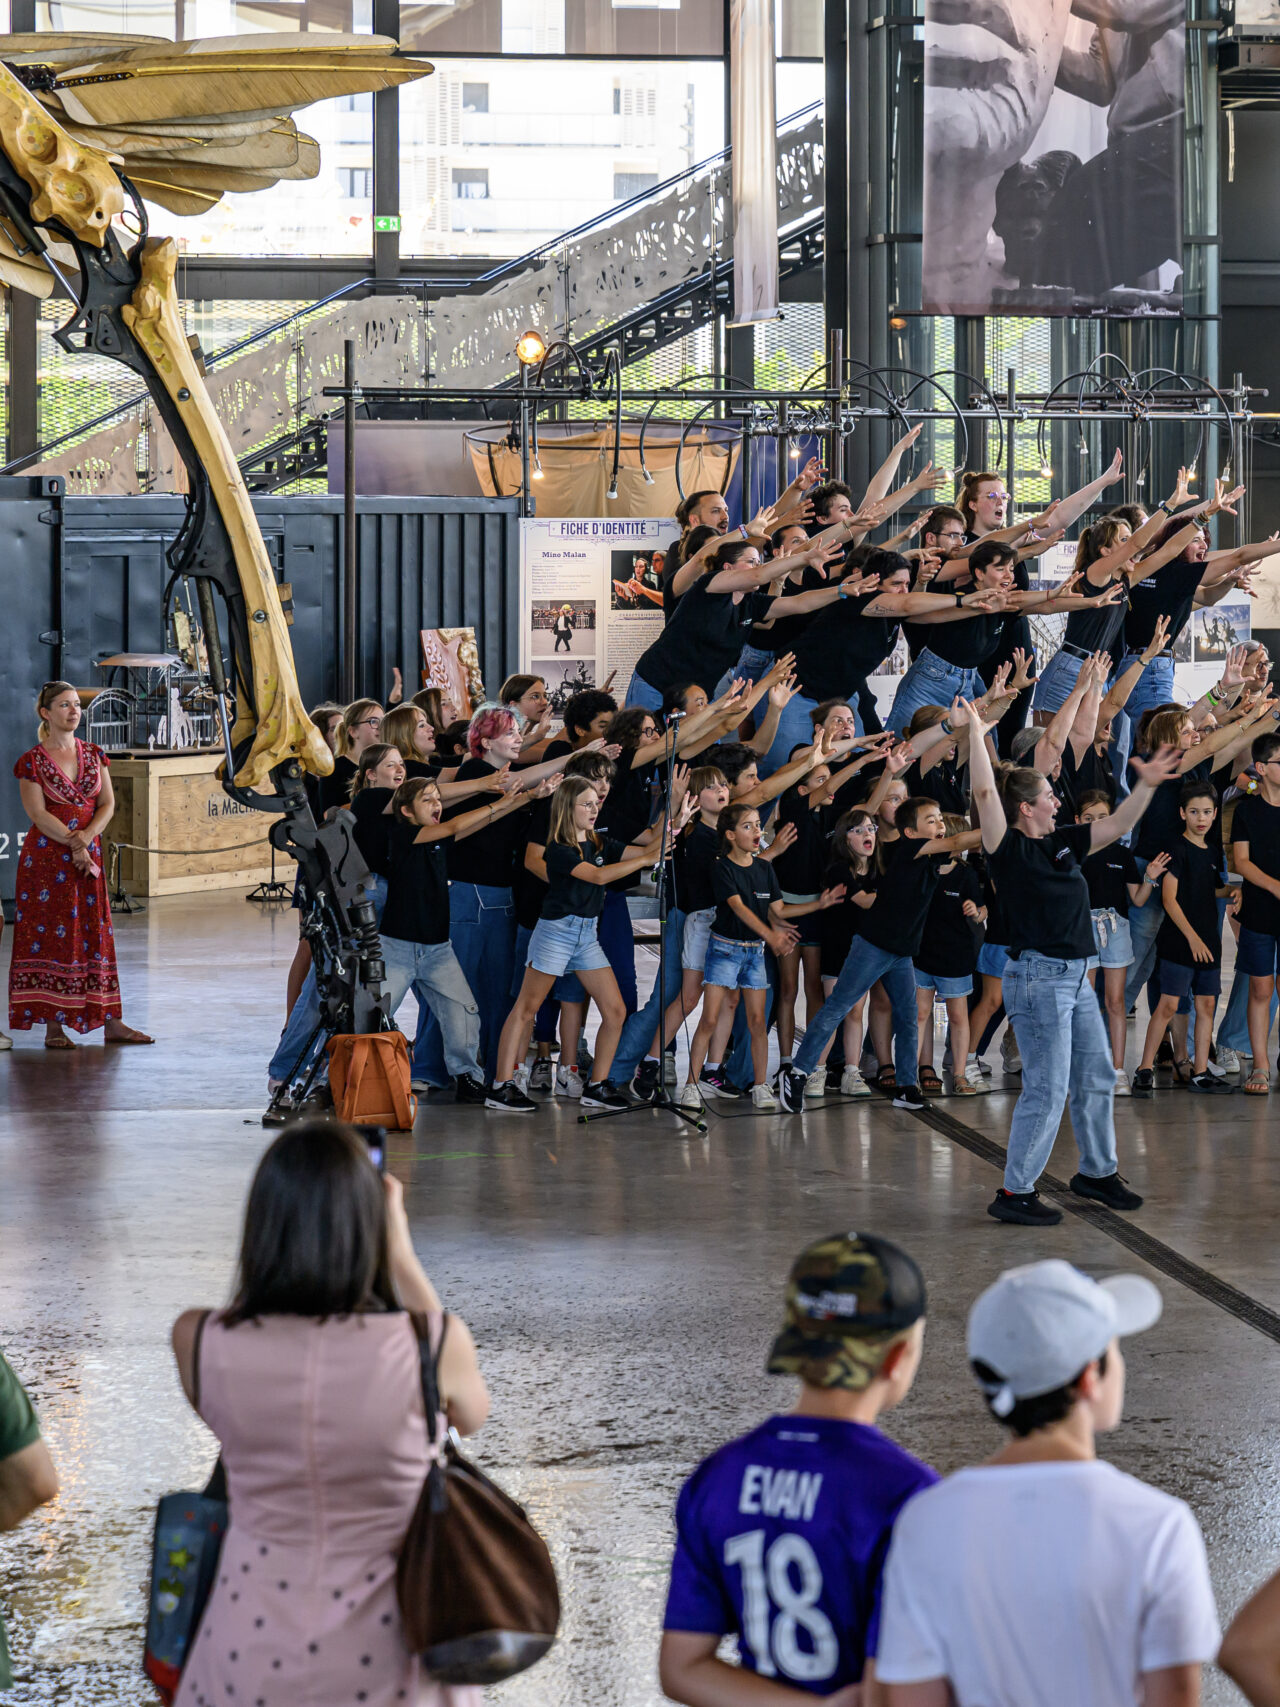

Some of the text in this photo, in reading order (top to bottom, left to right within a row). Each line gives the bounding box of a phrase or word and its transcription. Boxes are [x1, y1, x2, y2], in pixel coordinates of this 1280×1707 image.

[561, 519, 647, 535] FICHE D'IDENTITÉ
[1063, 544, 1078, 554] FICH
[208, 799, 218, 817] la
[738, 1464, 823, 1522] EVAN
[723, 1529, 840, 1682] 18
